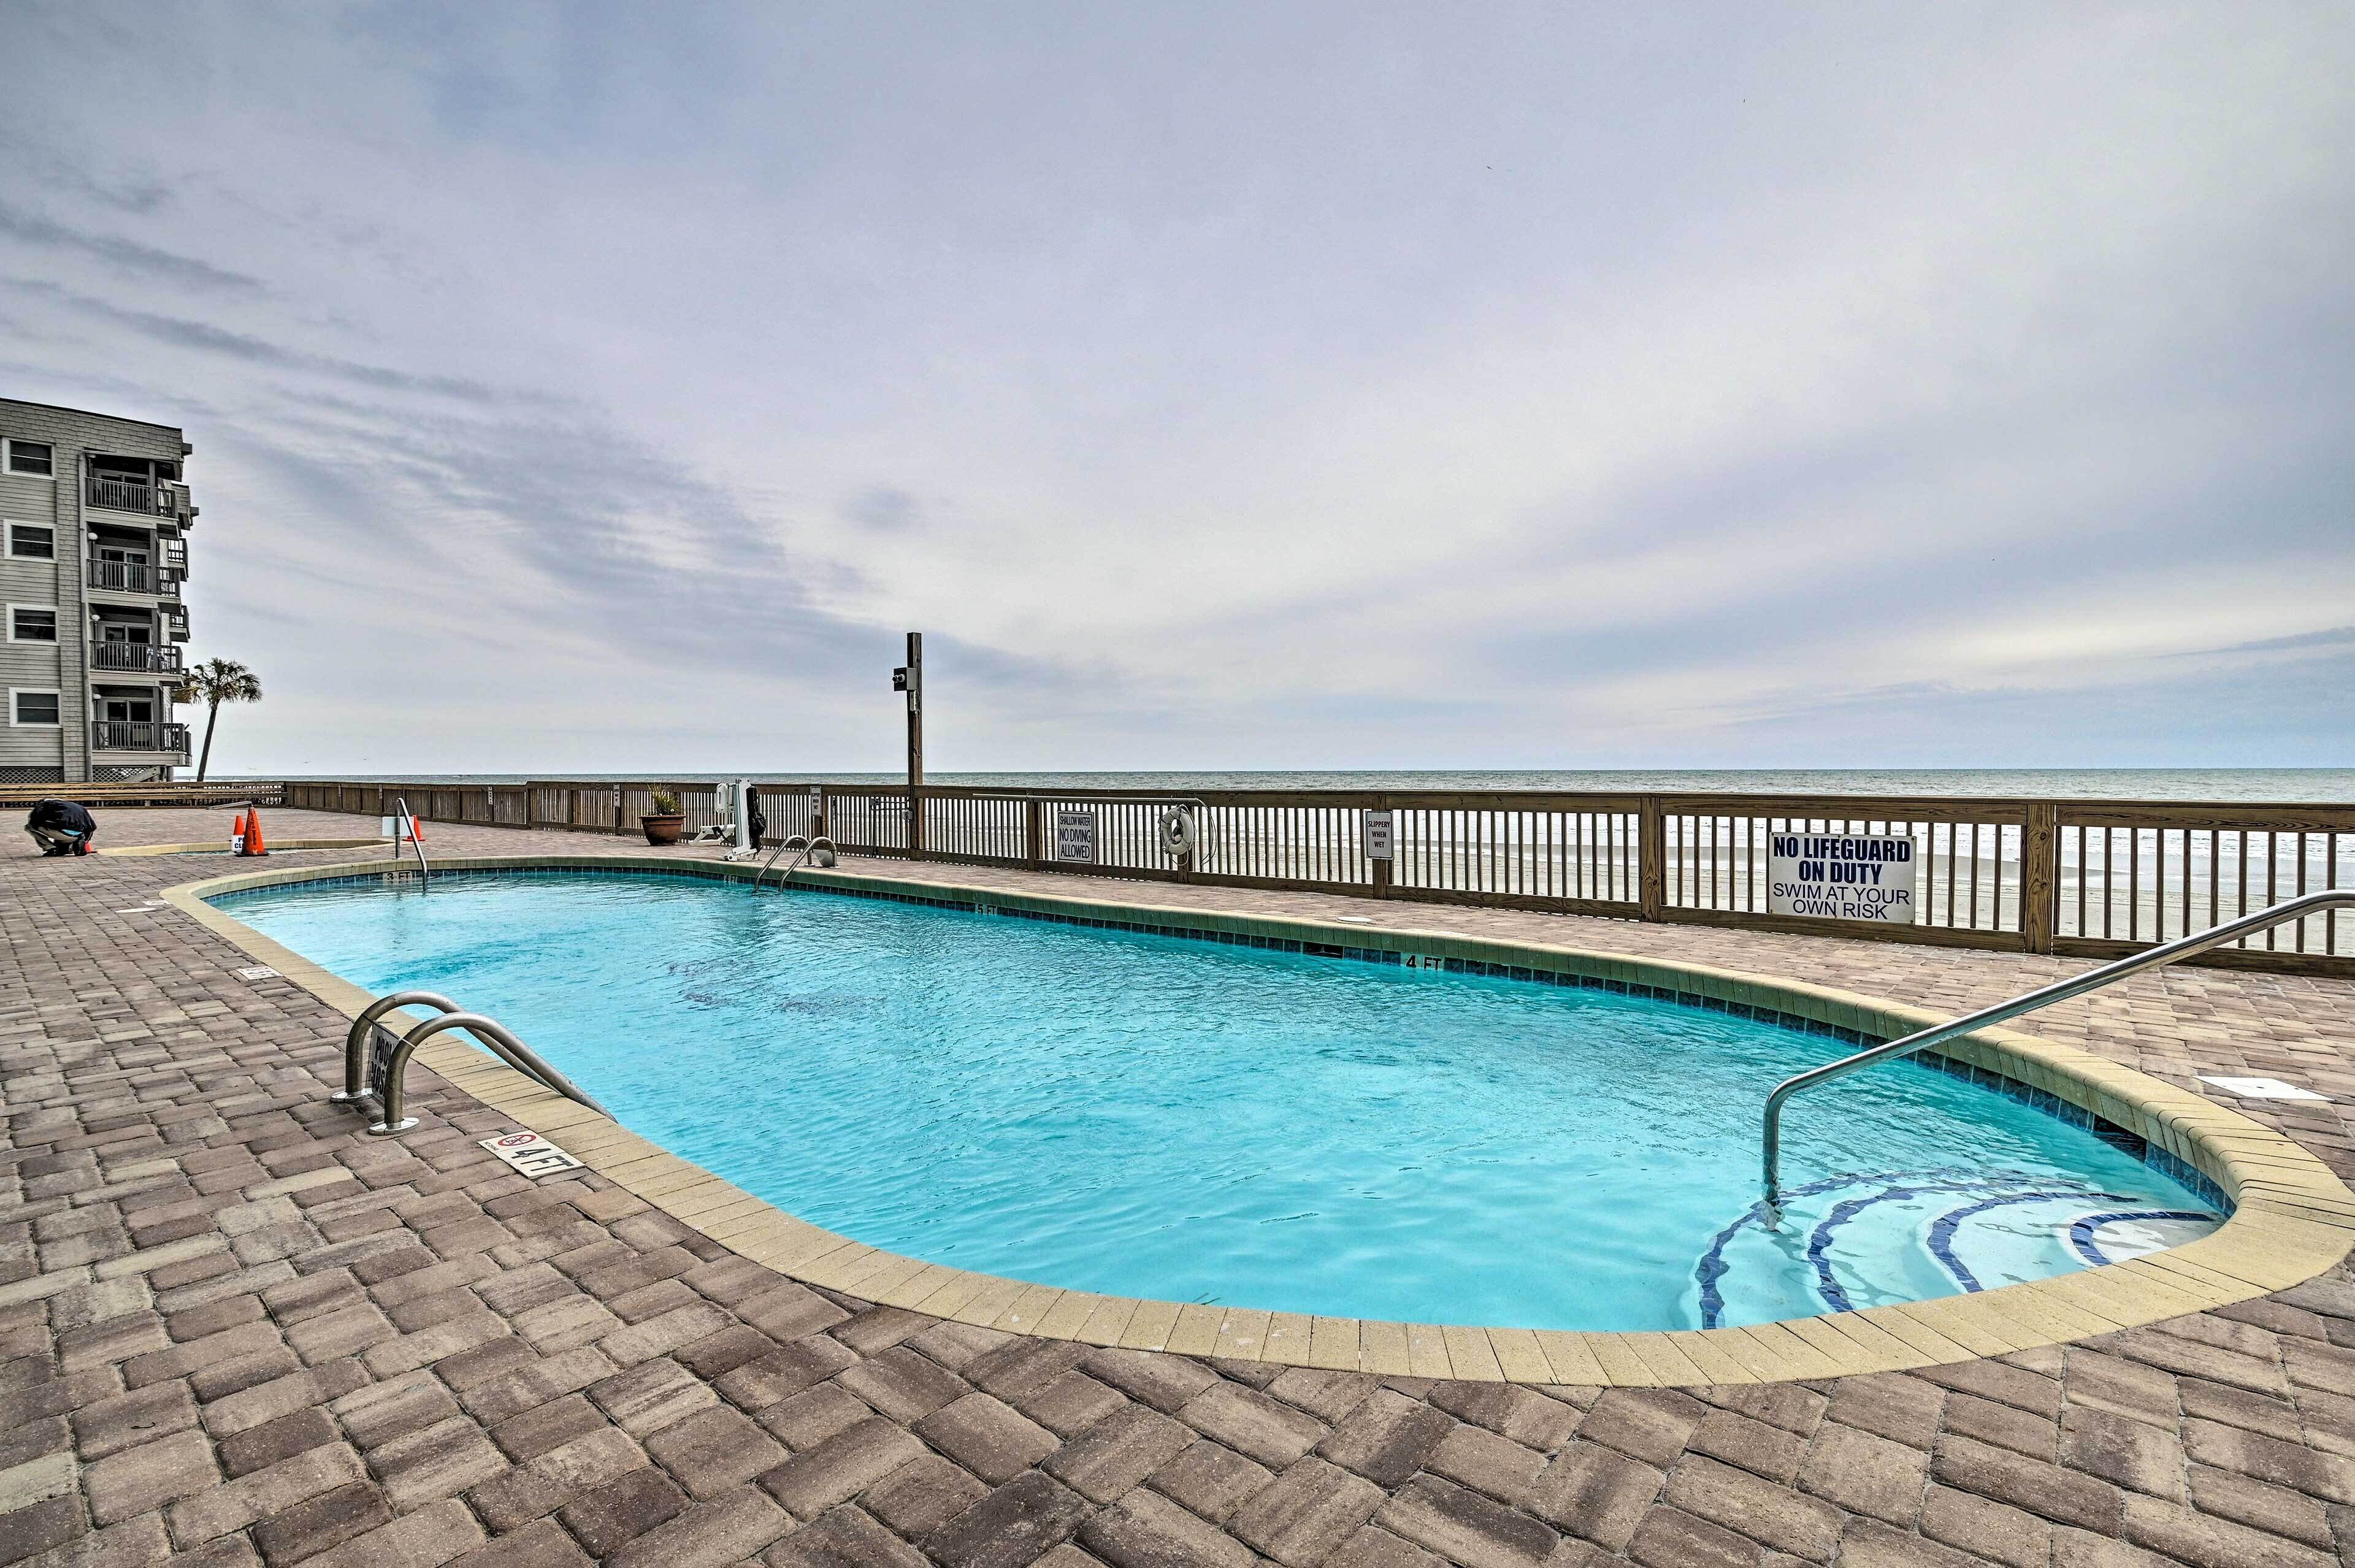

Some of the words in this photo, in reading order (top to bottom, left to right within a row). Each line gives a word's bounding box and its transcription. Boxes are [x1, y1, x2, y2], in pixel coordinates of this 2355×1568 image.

[1060, 816, 1077, 825] SHALLOW
[1077, 816, 1091, 827] WATER
[1060, 828, 1069, 841] NO
[1070, 828, 1091, 843] DIVING
[1060, 843, 1090, 859] ALLOWED
[1773, 836, 1799, 857] NO
[1804, 837, 1910, 862] LIFEGUARD
[1798, 860, 1825, 882] ON
[1830, 862, 1883, 885] DUTY
[1773, 882, 1821, 900] SWIM
[1825, 886, 1849, 901] AT
[1853, 887, 1910, 905] YOUR
[987, 904, 997, 914] FT
[1793, 899, 1837, 916] OWN
[1843, 902, 1888, 920] RISK
[1406, 955, 1416, 968] 4
[1423, 956, 1441, 970] FT
[511, 1147, 551, 1159] 4
[520, 1155, 575, 1171] FT
